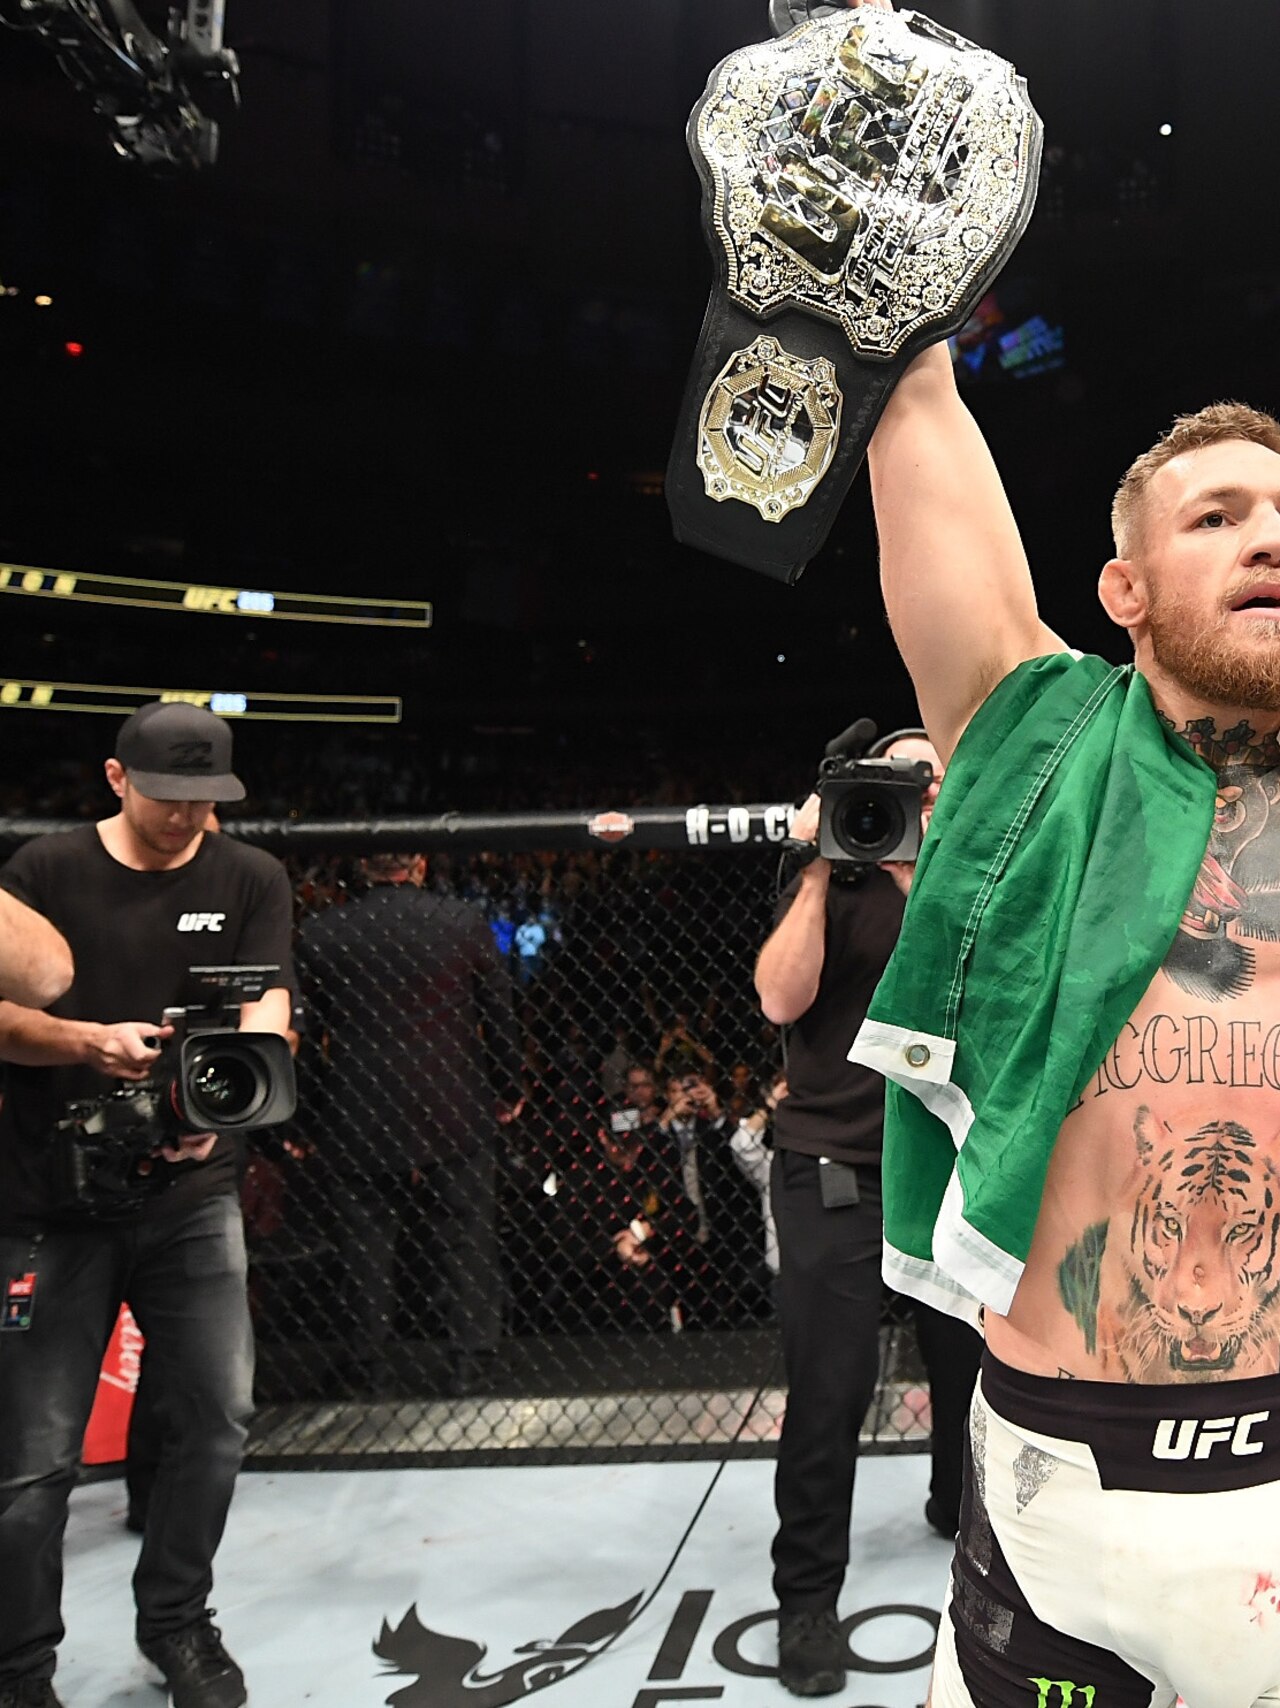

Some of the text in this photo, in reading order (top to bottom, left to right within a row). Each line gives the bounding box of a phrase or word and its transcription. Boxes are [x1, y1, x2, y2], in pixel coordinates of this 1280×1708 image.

[757, 24, 930, 286] UFC
[177, 912, 226, 932] UFC
[1152, 1411, 1269, 1460] UFC
